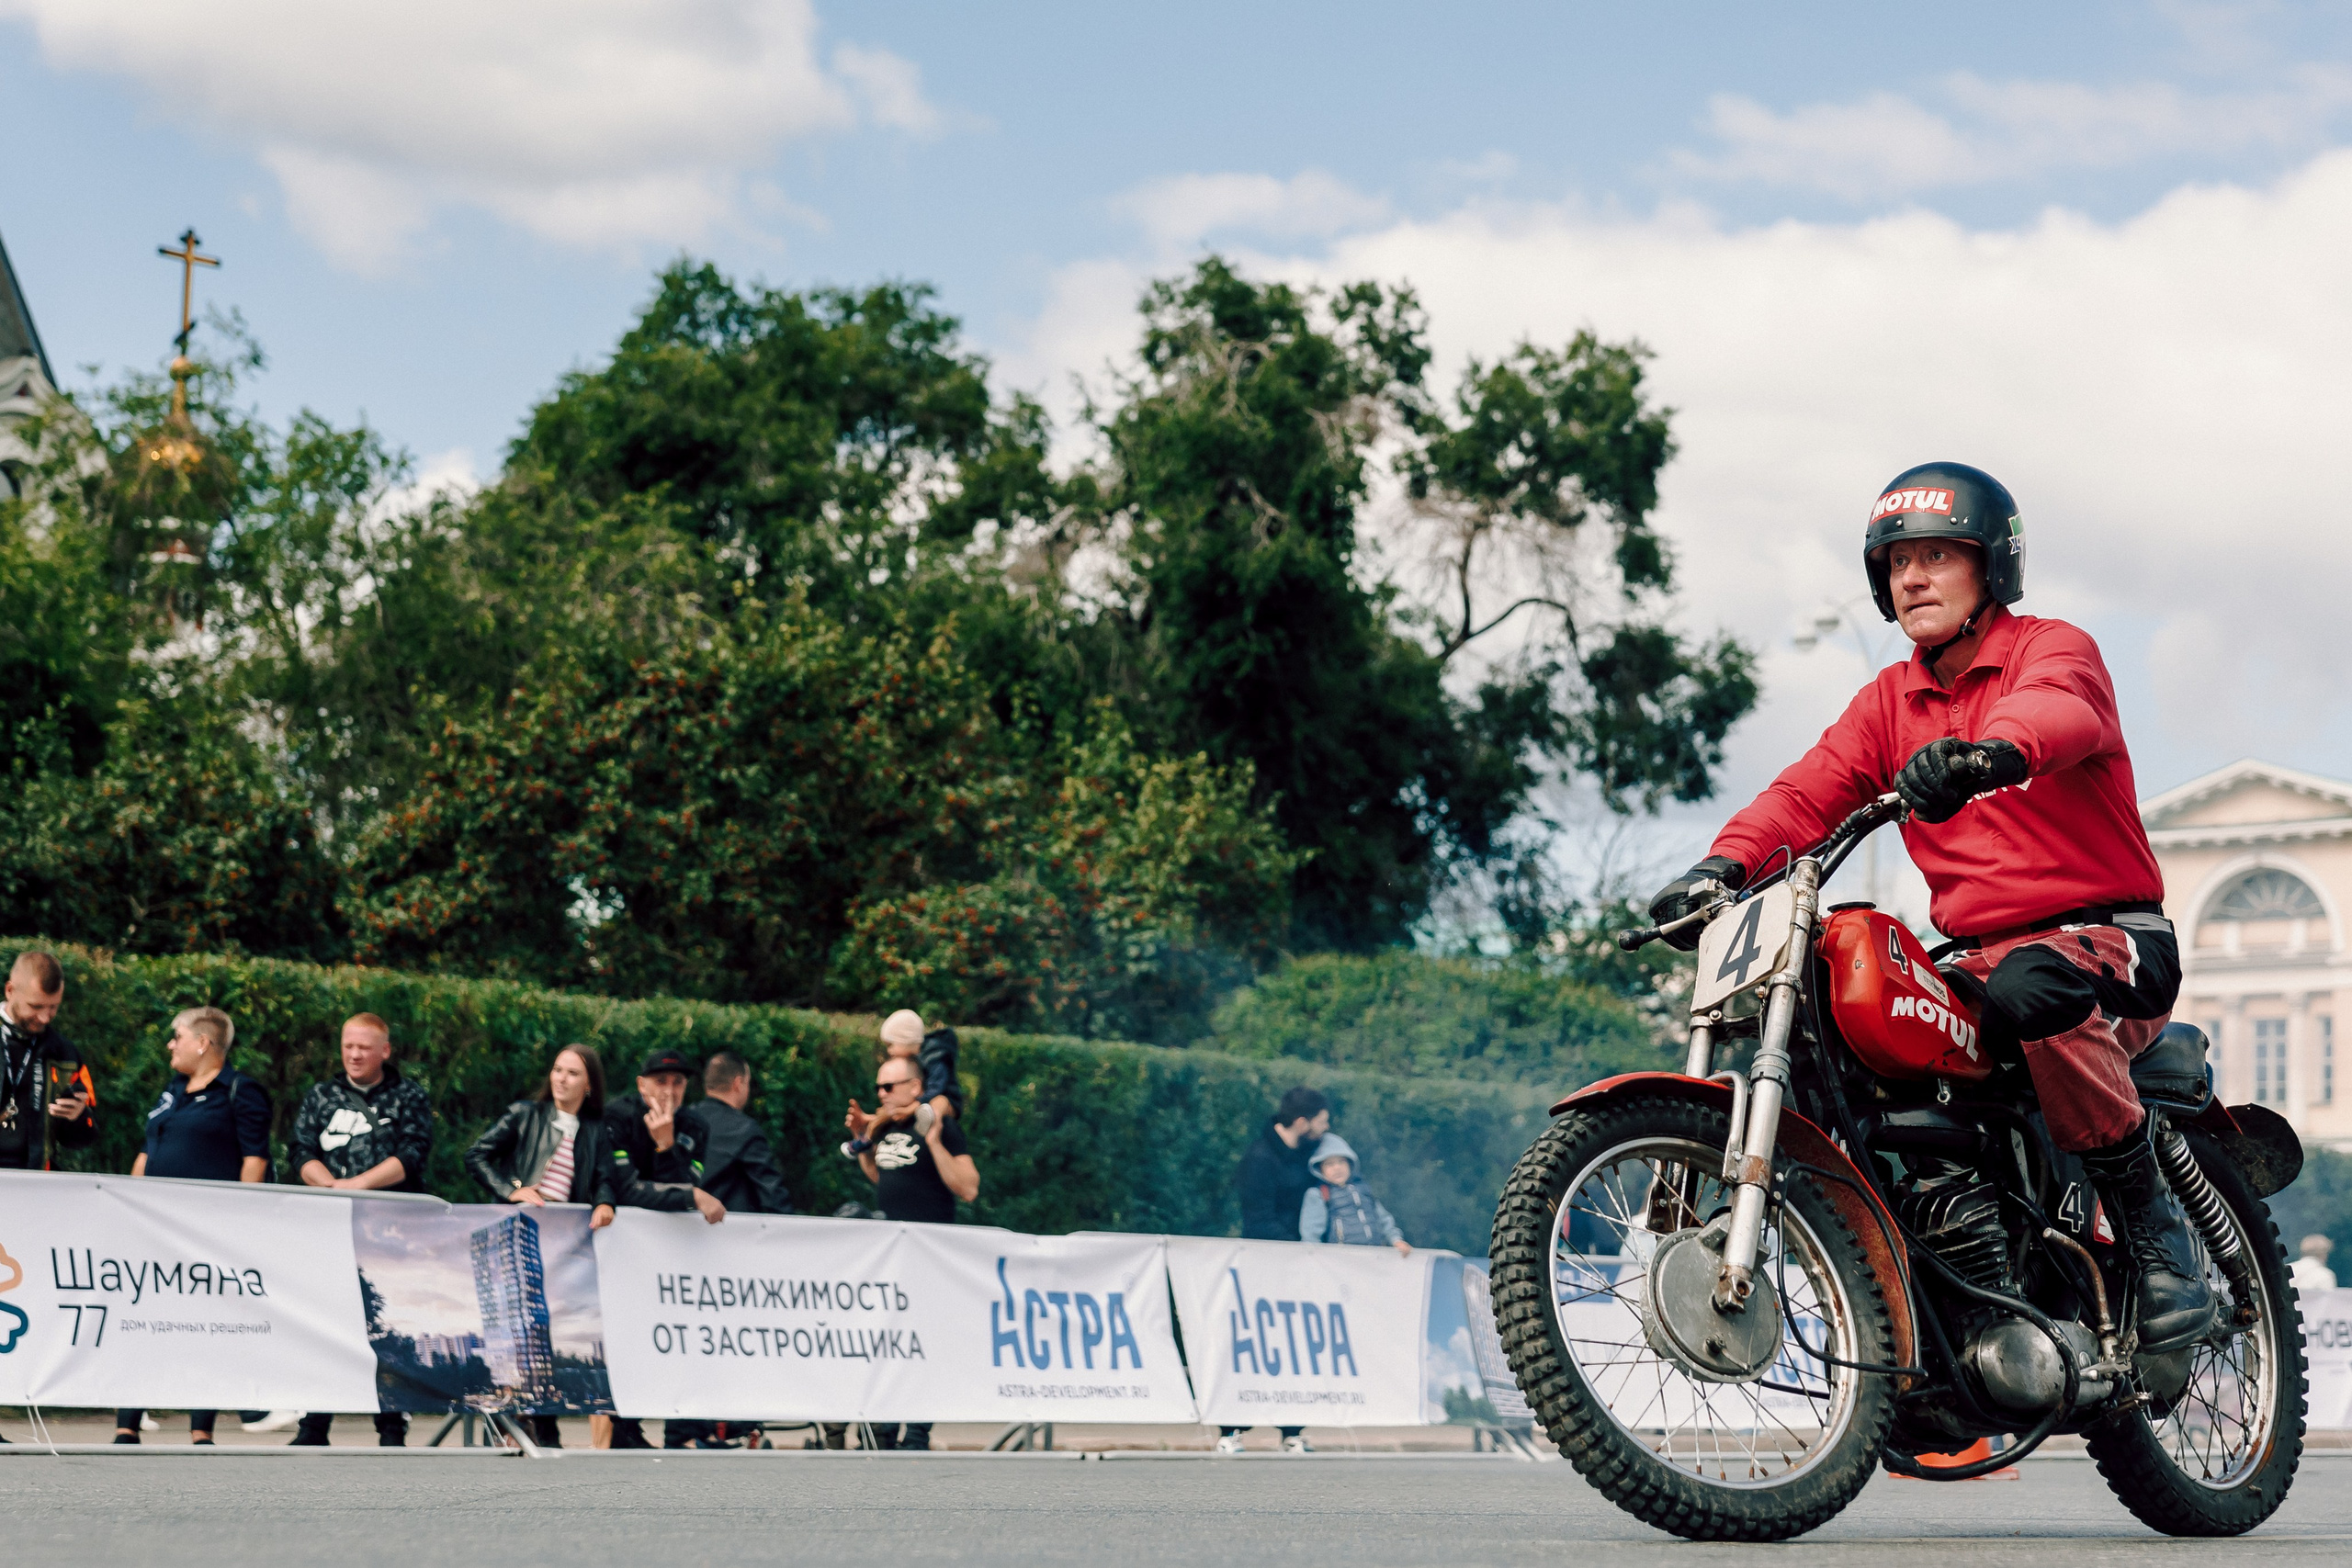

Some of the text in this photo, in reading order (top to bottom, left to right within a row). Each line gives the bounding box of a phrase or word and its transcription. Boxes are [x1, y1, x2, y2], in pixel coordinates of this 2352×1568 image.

[1871, 490, 1949, 521] MOTUL
[1715, 896, 1765, 988] 4
[1889, 924, 1909, 976] 4
[1891, 997, 1979, 1063] MOTUL
[2058, 1181, 2085, 1234] 4
[51, 1247, 268, 1305] Шаумяна
[657, 1272, 910, 1312] НЕДВИЖИМОСТЬ
[58, 1303, 108, 1348] 77
[120, 1319, 272, 1337] дом удачных решений
[653, 1321, 926, 1363] ОТ ЗАСТРОЙЩИКА
[998, 1383, 1150, 1399] ASTRA-DEVELOPMENT.RU
